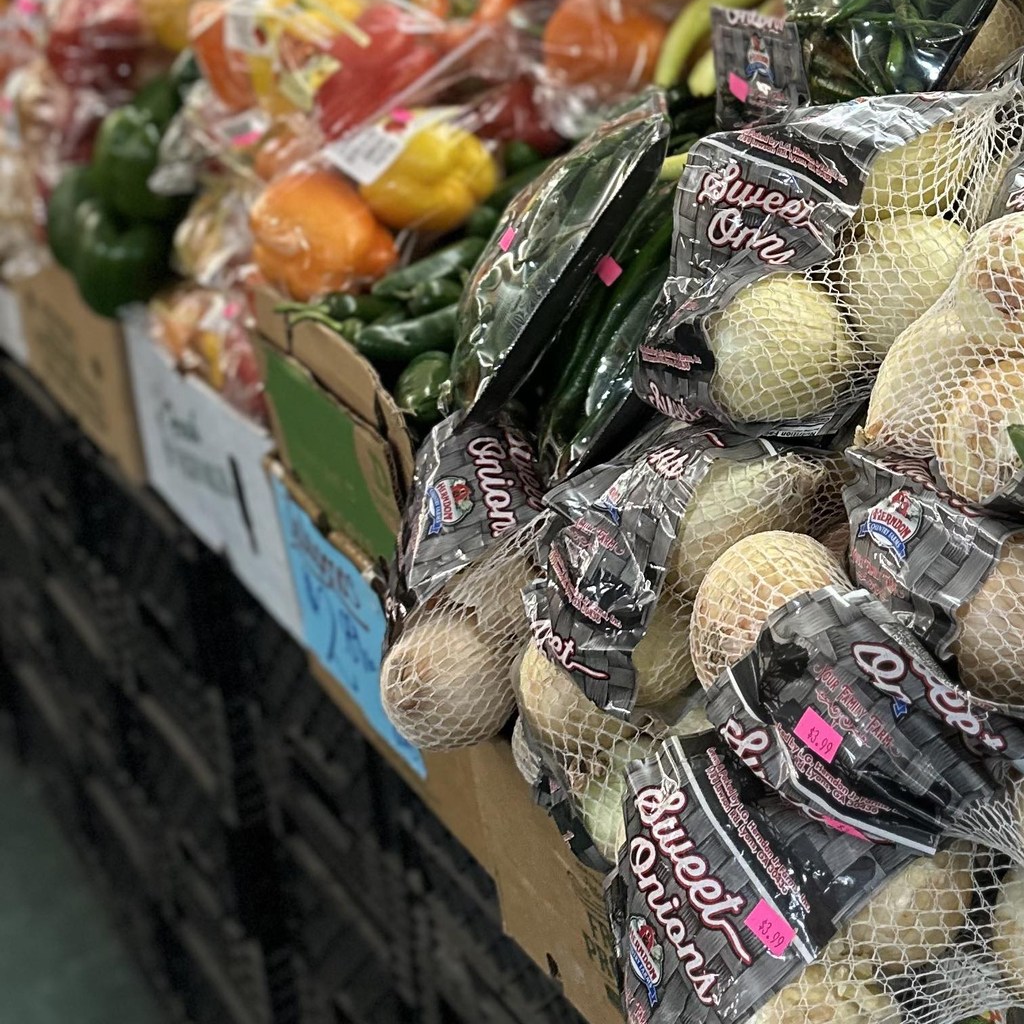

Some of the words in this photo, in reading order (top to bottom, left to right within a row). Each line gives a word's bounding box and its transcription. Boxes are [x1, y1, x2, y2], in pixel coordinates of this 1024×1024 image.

[436, 481, 454, 523] HERNDON
[466, 436, 519, 539] Onion
[871, 507, 912, 540] HERNDON
[814, 663, 841, 691] YOUR
[838, 684, 869, 718] FAMILY
[864, 715, 894, 747] FARM
[807, 726, 834, 755] $3.99
[806, 765, 831, 793] Lyons,
[814, 760, 849, 797] Herndon
[737, 822, 758, 855] Lyons,
[748, 819, 773, 860] Herndon
[634, 786, 752, 966] Sweet
[629, 835, 721, 1007] Onions
[757, 919, 786, 948] $3.99
